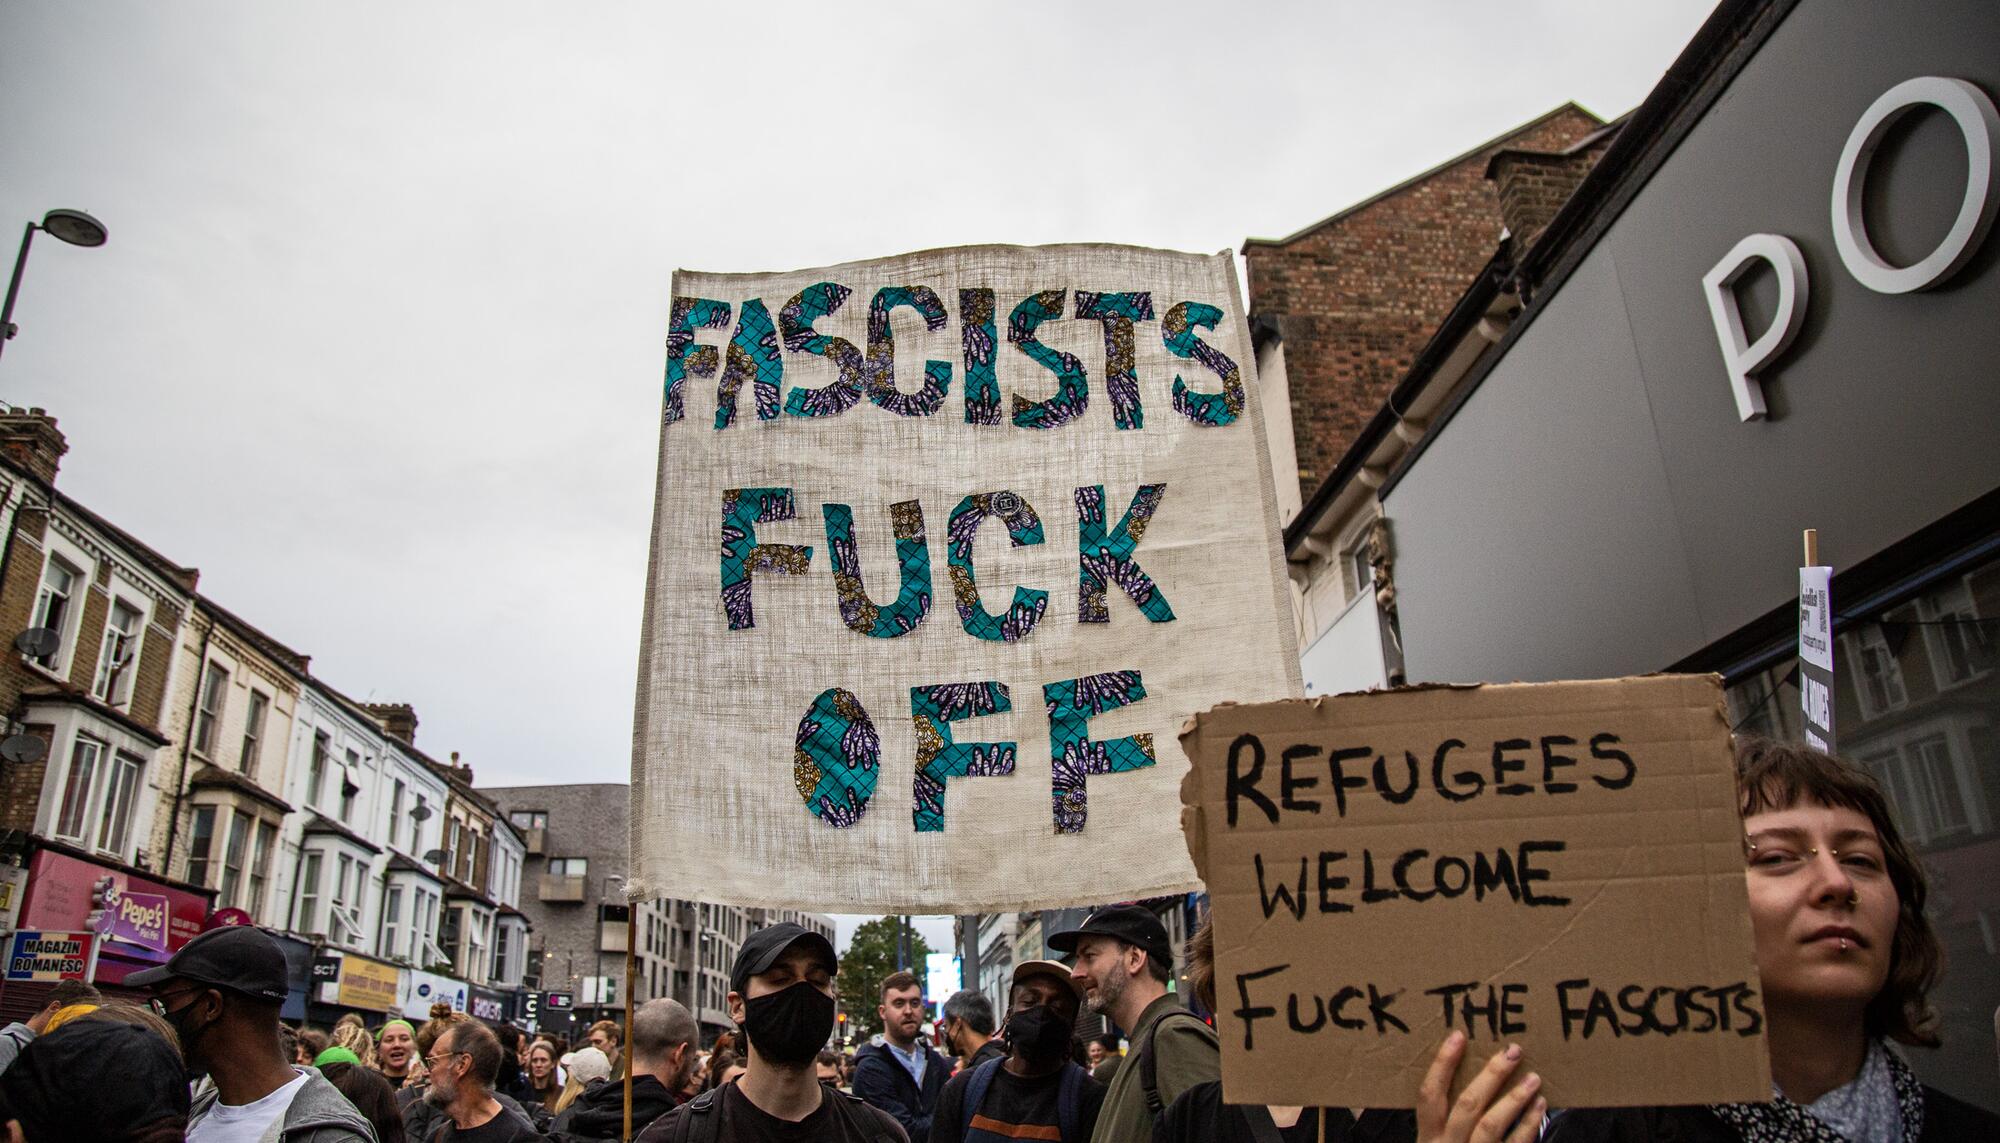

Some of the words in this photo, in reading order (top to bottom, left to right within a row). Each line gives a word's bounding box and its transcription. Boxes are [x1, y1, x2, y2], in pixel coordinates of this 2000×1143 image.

[665, 281, 1246, 430] FASCISTS
[719, 483, 1177, 644] FUCK
[794, 670, 1156, 835] OFF
[1225, 732, 1637, 829] REFUGEES
[120, 897, 163, 931] Pepe's
[1254, 840, 1572, 921] WELCOME
[13, 956, 83, 973] ROMANESC
[24, 939, 82, 954] MAGAZIN
[1233, 964, 1410, 1051] FUCK
[1424, 981, 1529, 1042] THE
[1556, 978, 1763, 1042] FASCISTS
